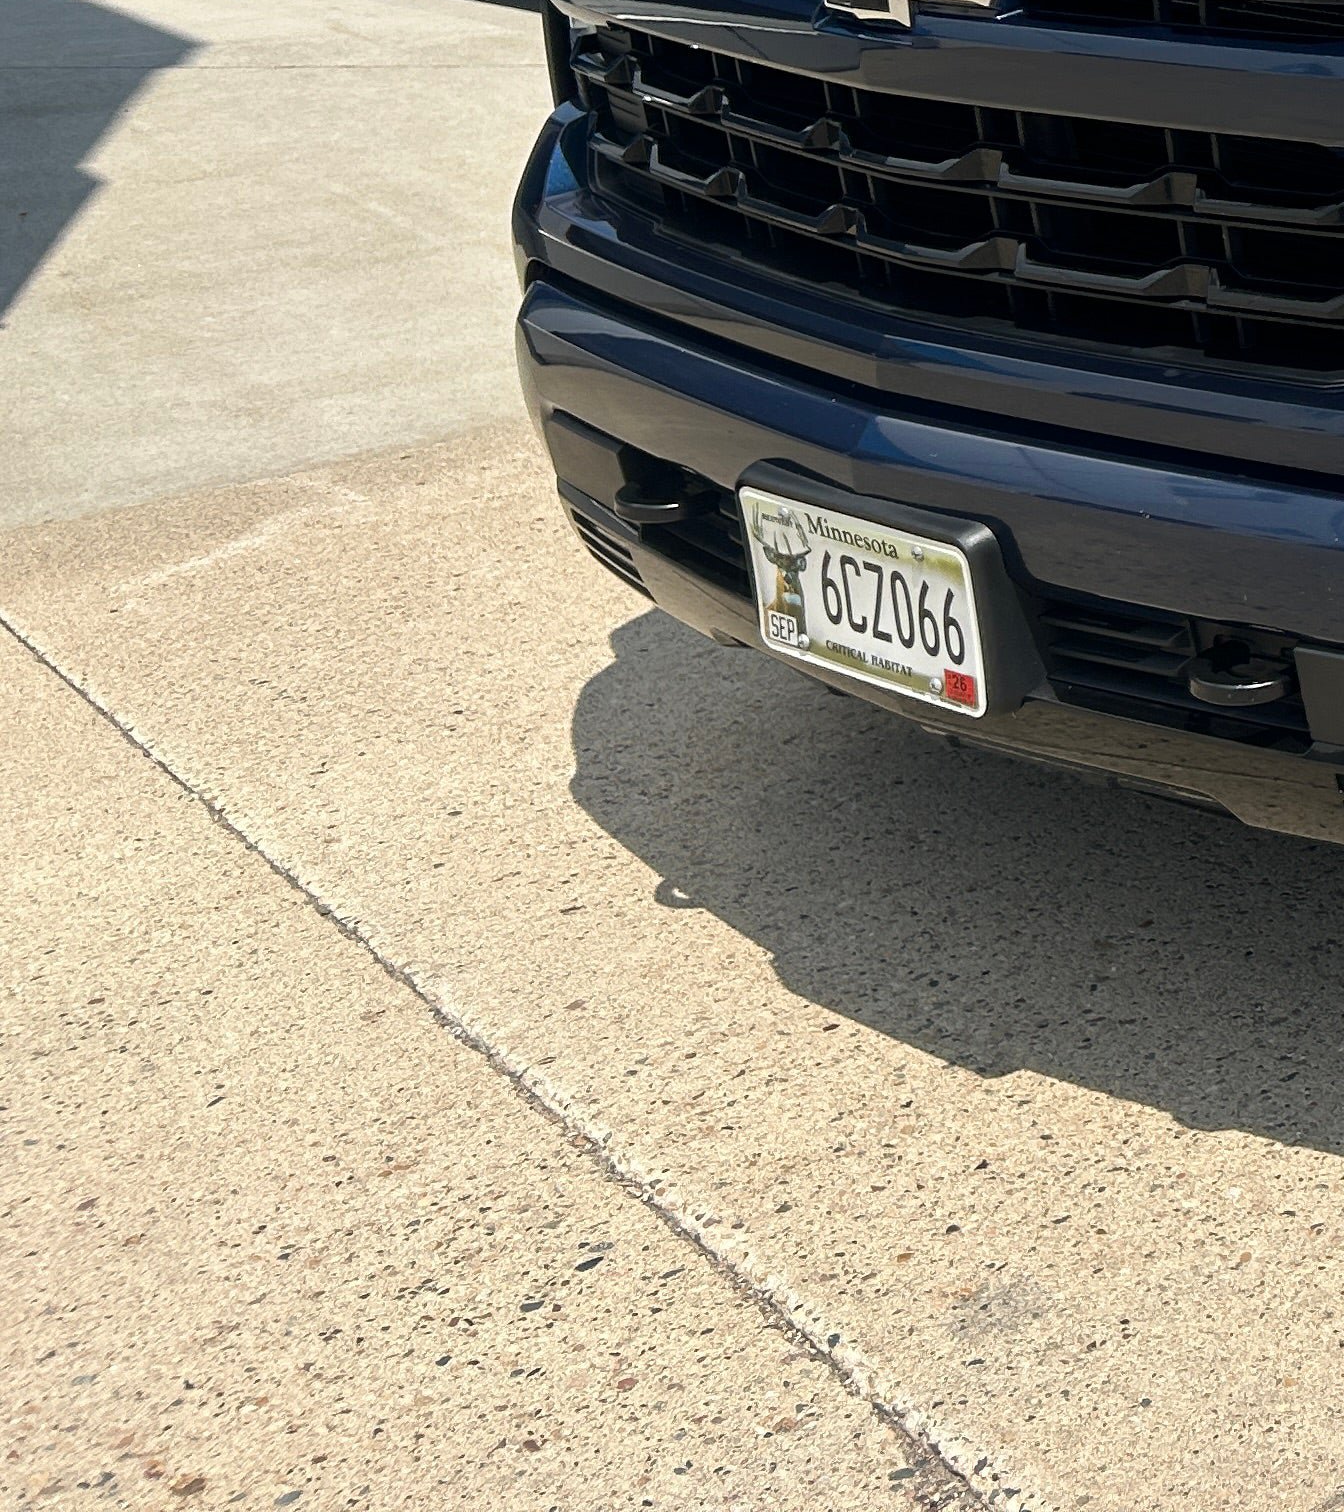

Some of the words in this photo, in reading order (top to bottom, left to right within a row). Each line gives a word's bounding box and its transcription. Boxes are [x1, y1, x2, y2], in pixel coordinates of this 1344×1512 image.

[804, 512, 900, 560] Minnesota
[770, 613, 796, 642] SEP
[821, 550, 966, 666] 6CZ066
[825, 639, 869, 664] CRITICAL
[871, 654, 913, 678] HABITAT
[952, 673, 967, 692] 26
